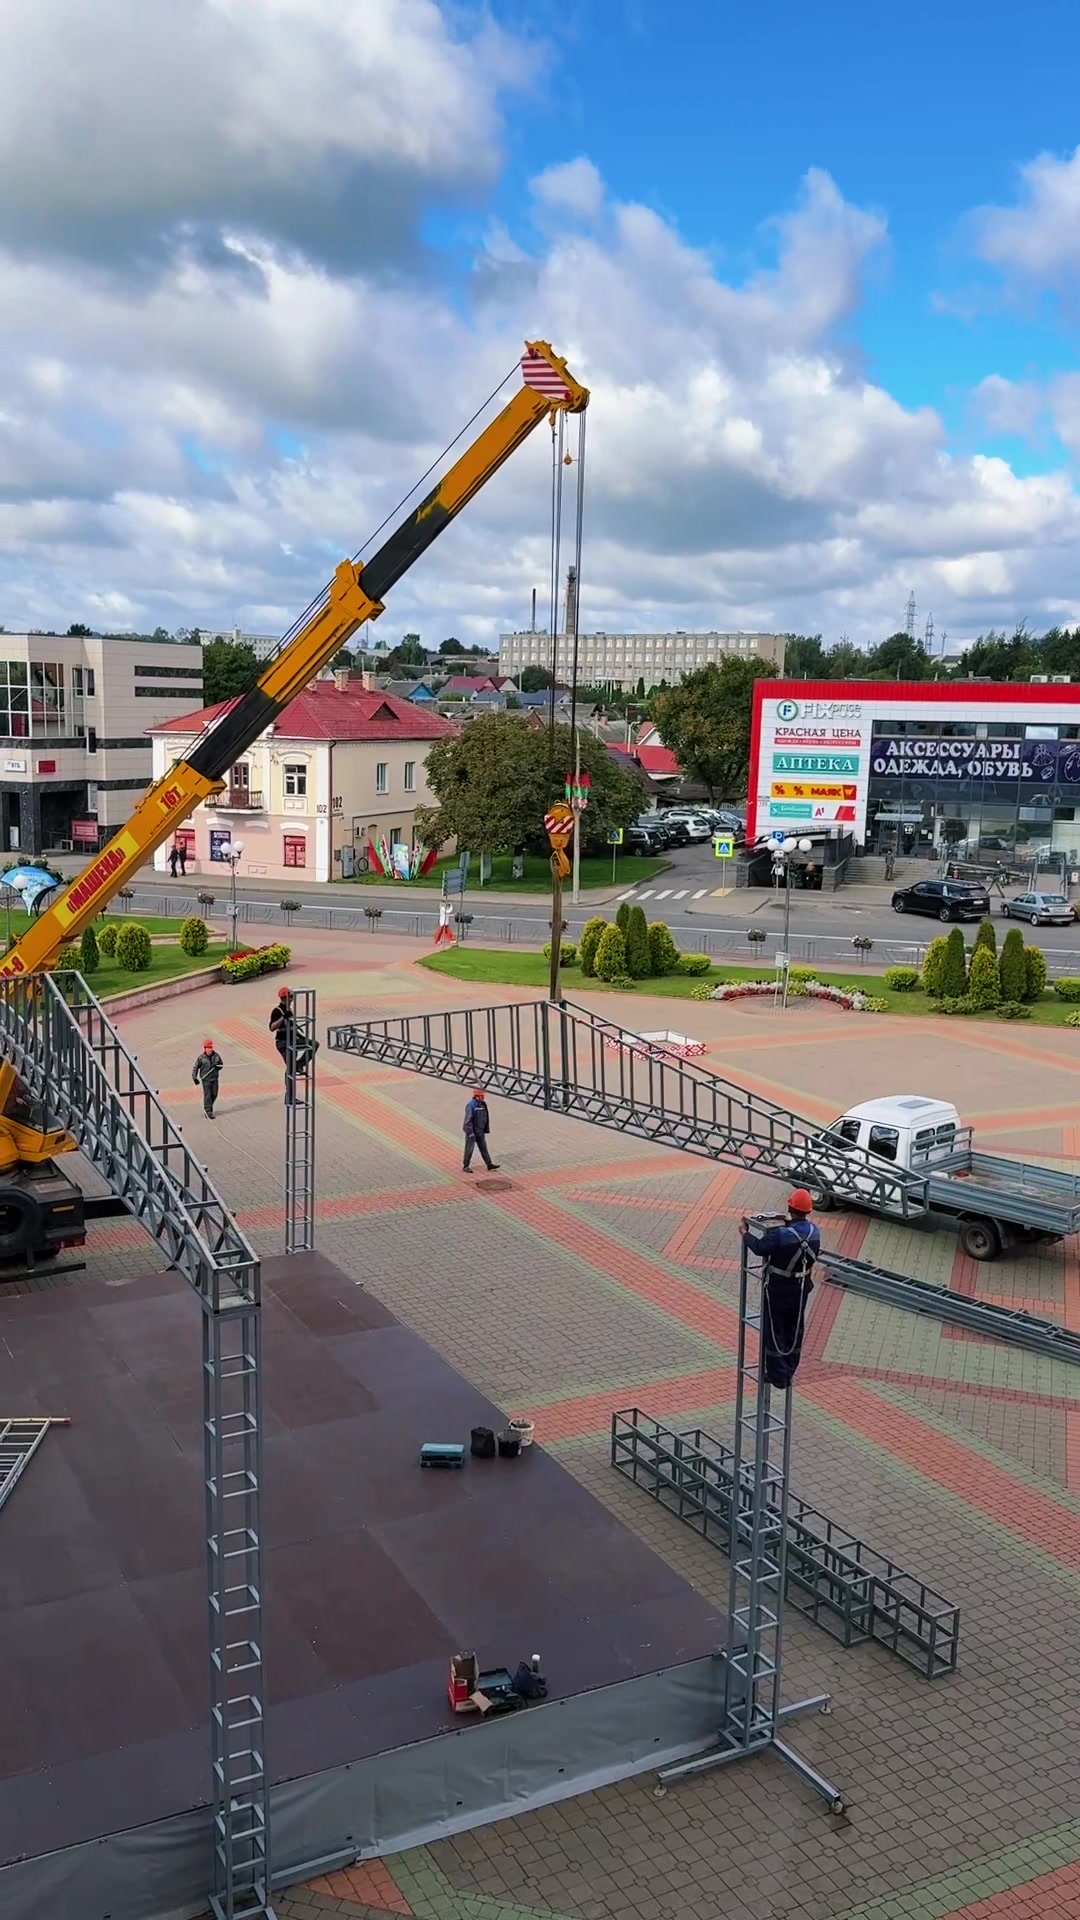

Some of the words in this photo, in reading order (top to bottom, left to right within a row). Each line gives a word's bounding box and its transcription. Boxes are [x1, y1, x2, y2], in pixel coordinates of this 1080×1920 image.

[775, 727, 826, 737] КРАСНАЯ
[832, 729, 862, 738] ЦЕНА
[885, 741, 1021, 759] АКСЕССУАРЫ
[776, 757, 854, 771] АПТЕКА
[873, 758, 963, 778] ОДЕЖДА,
[967, 761, 1034, 777] ОБУВЬ
[811, 788, 842, 797] МАЯК
[316, 804, 327, 813] 102
